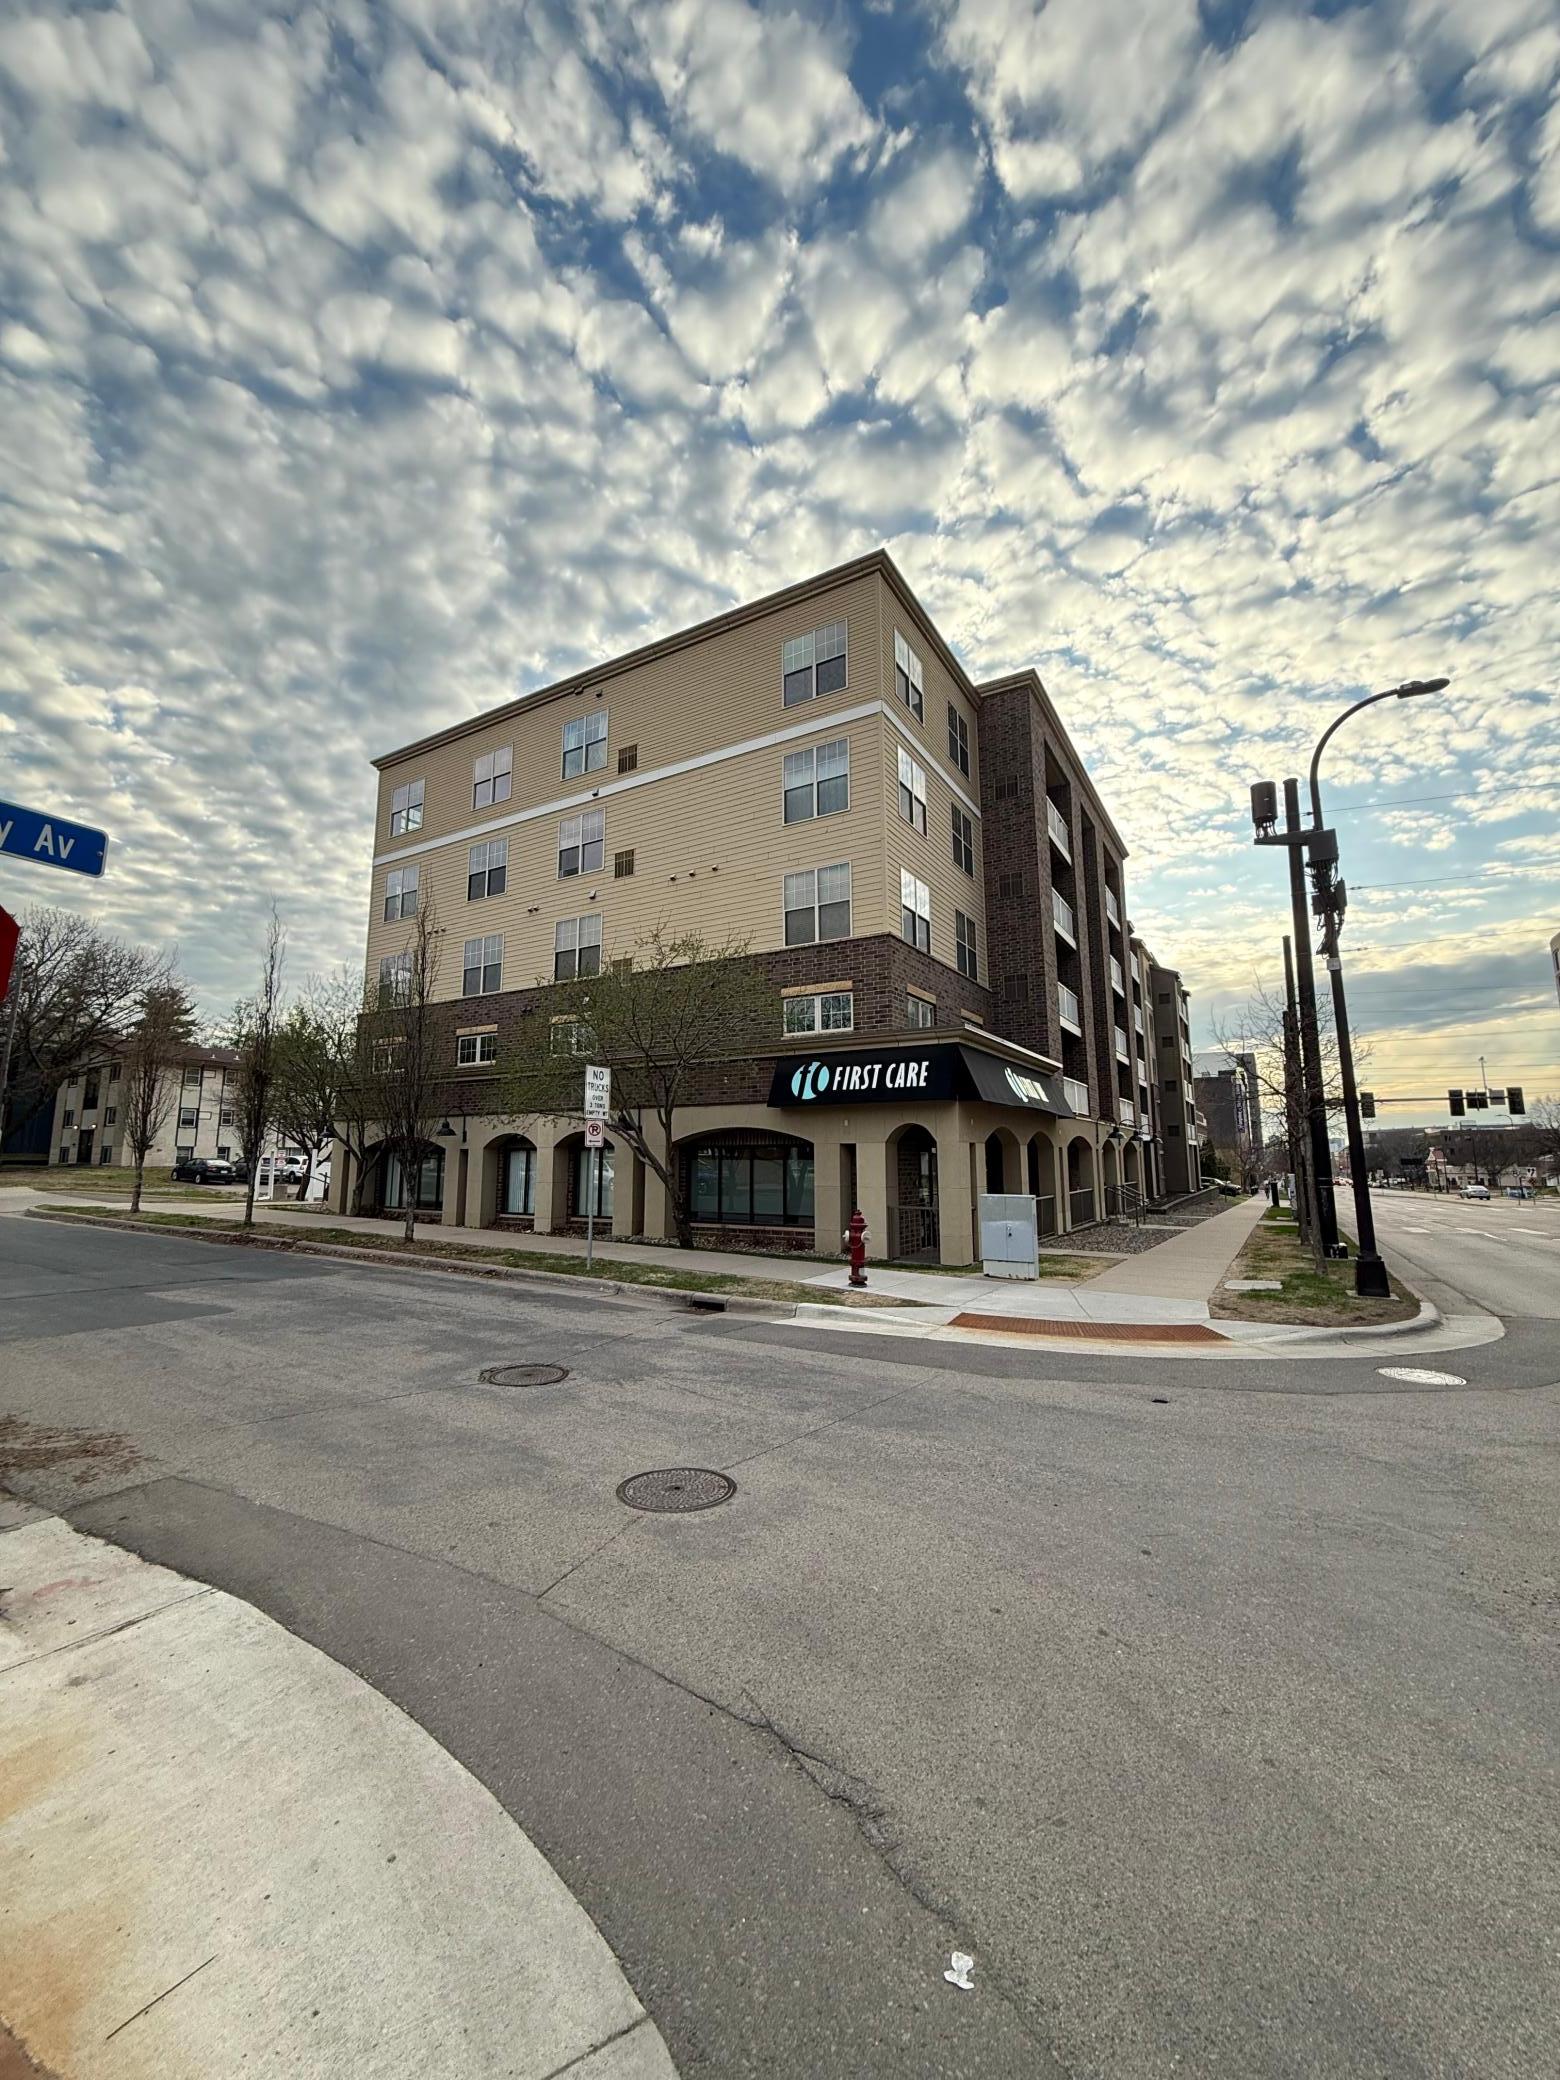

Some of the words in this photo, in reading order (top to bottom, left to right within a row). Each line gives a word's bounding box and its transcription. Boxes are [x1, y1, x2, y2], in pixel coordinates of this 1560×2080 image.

[34, 823, 75, 859] Av
[592, 1070, 605, 1081] NO
[832, 1064, 882, 1091] FIRST
[886, 1061, 930, 1089] CARE
[587, 1081, 609, 1093] TRUCKS
